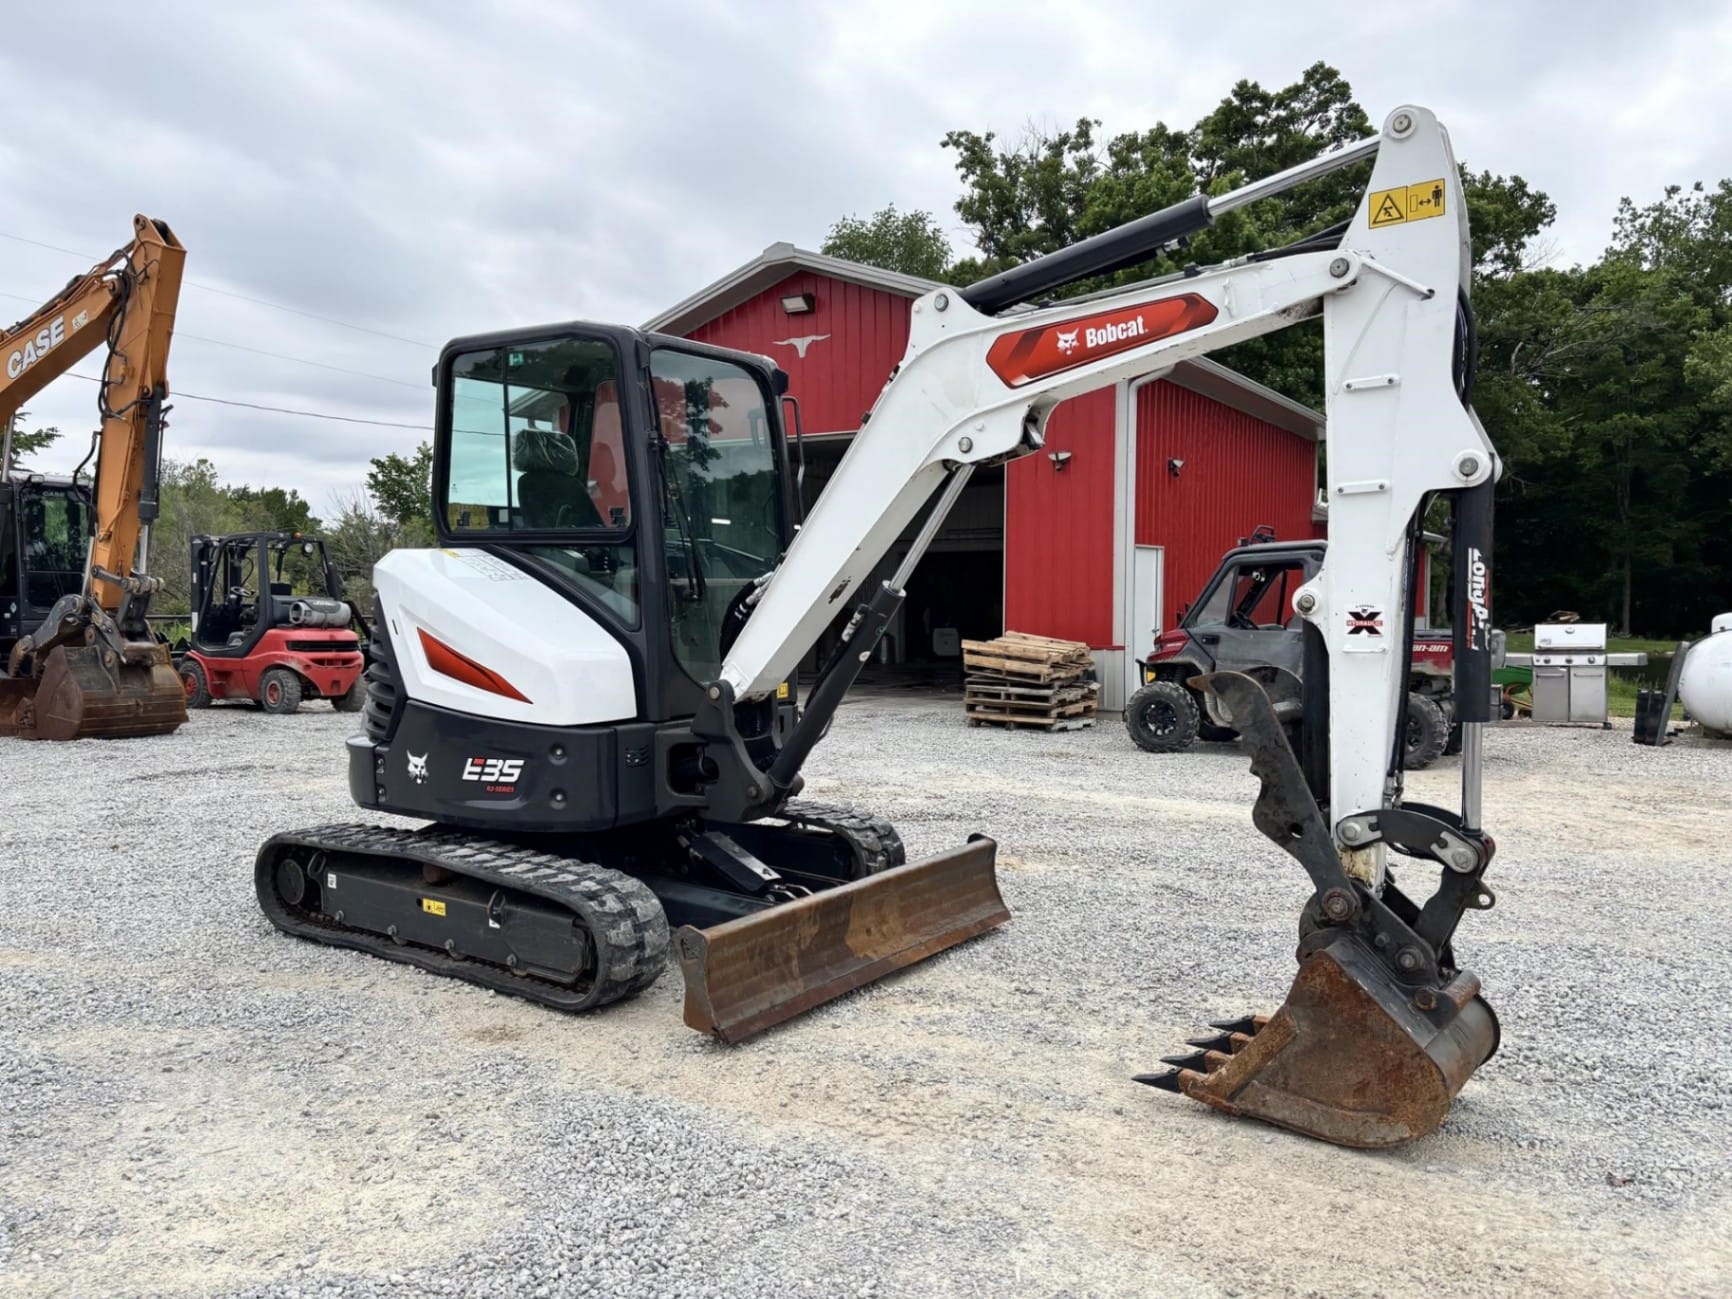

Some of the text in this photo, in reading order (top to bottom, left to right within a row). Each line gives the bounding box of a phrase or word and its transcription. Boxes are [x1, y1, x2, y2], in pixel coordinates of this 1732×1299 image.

[1085, 315, 1146, 348] Bobcat
[7, 315, 65, 378] CASE
[1412, 644, 1449, 653] an-am
[462, 757, 525, 783] E35
